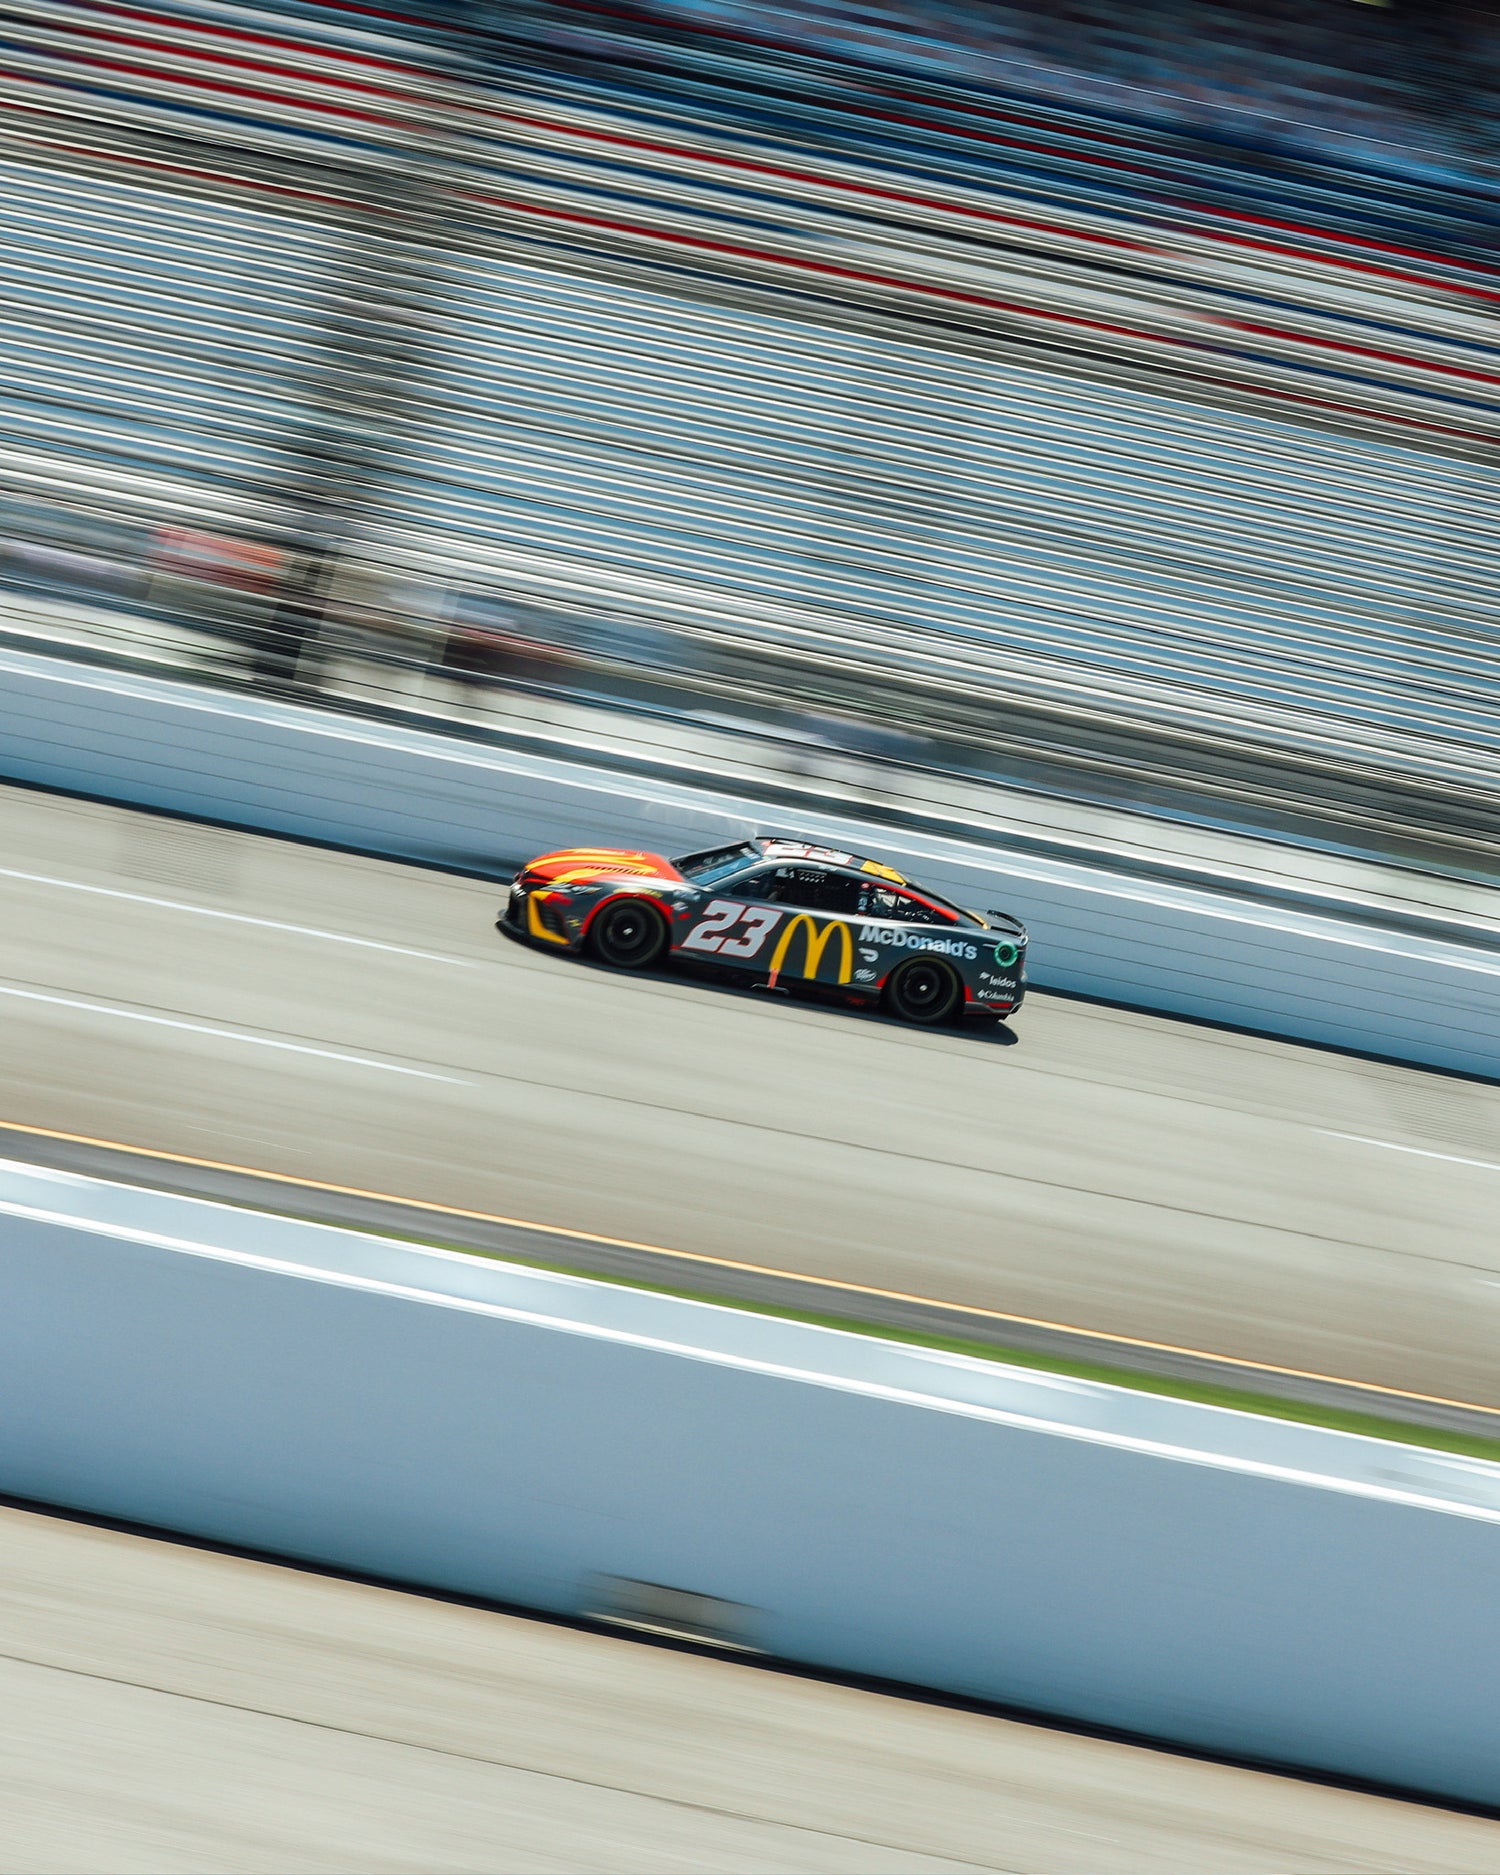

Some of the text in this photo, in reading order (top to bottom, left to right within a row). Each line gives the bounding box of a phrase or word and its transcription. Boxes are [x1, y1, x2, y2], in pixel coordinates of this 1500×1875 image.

[681, 899, 784, 959] 23
[858, 925, 978, 960] McDonald's
[989, 975, 1017, 989] leidos
